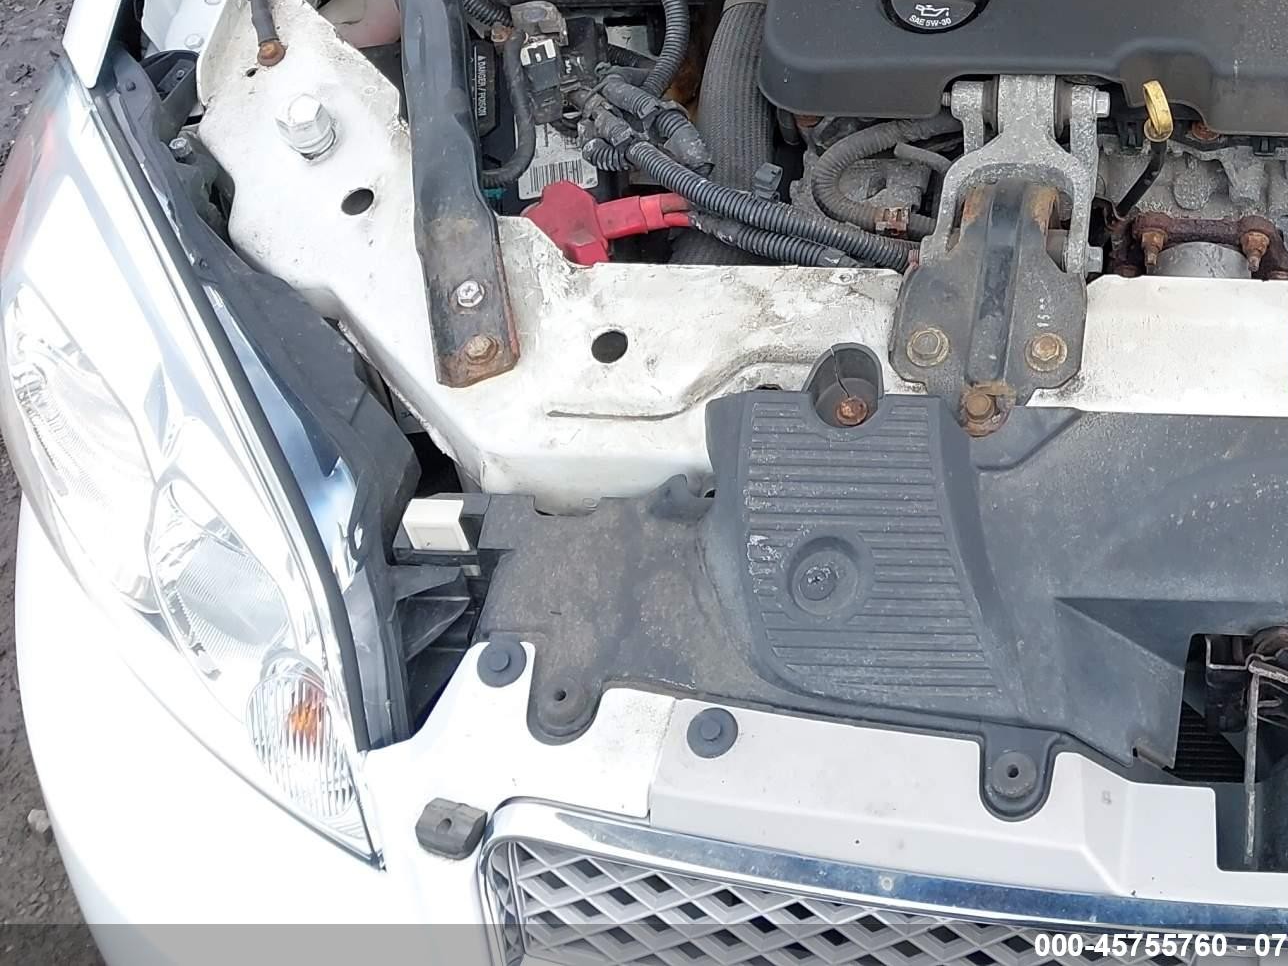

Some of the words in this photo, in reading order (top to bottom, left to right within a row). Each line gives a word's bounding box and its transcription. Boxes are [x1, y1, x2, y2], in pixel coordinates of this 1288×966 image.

[909, 15, 925, 26] SAE
[925, 18, 952, 27] 5W-30
[477, 60, 487, 86] DANGER
[477, 92, 487, 117] POISON
